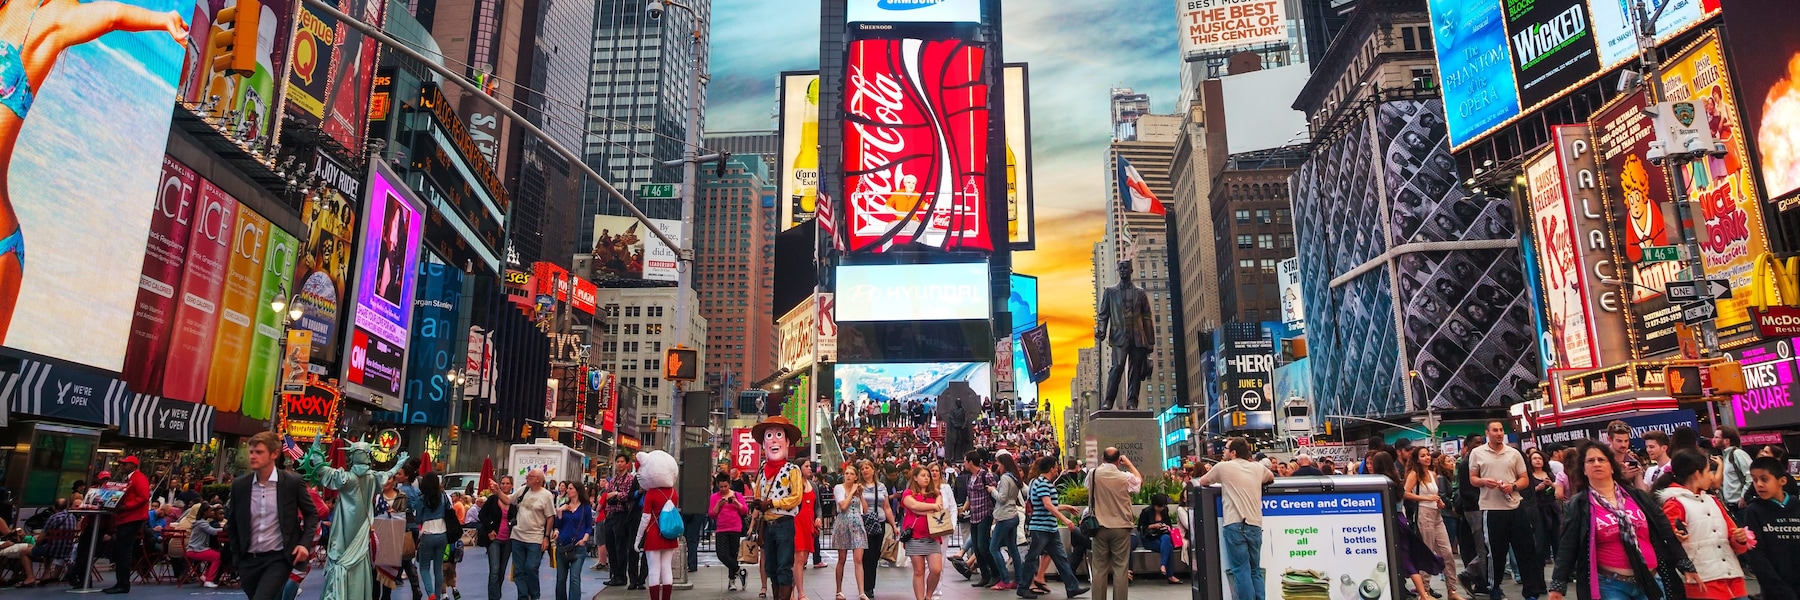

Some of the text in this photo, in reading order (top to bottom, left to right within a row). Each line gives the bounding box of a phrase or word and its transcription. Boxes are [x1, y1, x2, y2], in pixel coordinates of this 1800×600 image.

[1230, 1, 1277, 19] BEST
[1673, 0, 1689, 11] ABBA
[1190, 15, 1279, 35] MUSICAL OF
[1191, 33, 1219, 45] THIS
[1616, 31, 1631, 44] SMASH
[292, 28, 317, 86] Q
[1463, 45, 1478, 60] The
[1446, 44, 1504, 92] PHANTOM
[1694, 54, 1711, 75] Jessie
[1692, 65, 1720, 92] MUELLER
[1460, 86, 1499, 118] OPERA
[1615, 105, 1639, 126] ULTIMATE
[1600, 123, 1627, 145] FEEL-GOOD
[1610, 123, 1641, 148] IS BACK AND
[1605, 145, 1622, 160] BETTER
[1621, 136, 1636, 150] THAN
[164, 157, 195, 181] SPARKLING
[796, 170, 817, 180] Coro
[314, 154, 360, 202] A JOY RIDE!
[154, 168, 193, 226] ICE
[206, 184, 233, 205] SPARKLING
[643, 186, 650, 197] W
[651, 186, 661, 197] 46
[1535, 182, 1563, 212] CELEBRAT
[198, 195, 231, 247] ICE
[660, 223, 669, 233] By
[1571, 139, 1618, 312] PALACE
[160, 235, 185, 253] Raspberry
[236, 218, 263, 265] ICE
[268, 239, 292, 281] ICE
[652, 248, 673, 257] did it.
[1644, 250, 1652, 260] W
[1654, 249, 1666, 260] 46
[1712, 255, 1722, 266] You
[1722, 253, 1732, 265] Can
[1732, 246, 1741, 257] Get
[140, 278, 172, 295] ZERO CALORIES
[1633, 260, 1681, 301] Annie
[887, 284, 981, 300] HYUNDAI
[1672, 287, 1692, 297] ONE
[414, 300, 453, 311] organ Stanley
[1687, 308, 1698, 319] ONE
[302, 317, 329, 335] ON BROADWAY
[1762, 315, 1800, 325] McDo
[1235, 354, 1275, 373] HERO
[73, 384, 93, 397] WE'RE
[1238, 379, 1263, 388] JUNE 6
[71, 396, 88, 407] OPEN
[288, 394, 333, 417] ROXY
[1741, 385, 1794, 414] SQUARE
[172, 408, 188, 420] WE'RE
[169, 420, 185, 431] OPEN
[1542, 429, 1584, 444] BOX OFFICE HERE
[738, 431, 757, 467] tkts
[1262, 498, 1376, 510] YC Green and Clean!
[1284, 526, 1319, 536] recycle
[1342, 525, 1376, 534] recycle
[1763, 523, 1800, 532] abercro
[1296, 537, 1308, 545] all
[1343, 536, 1377, 544] bottles
[1289, 549, 1317, 559] paper
[1345, 547, 1352, 555] &
